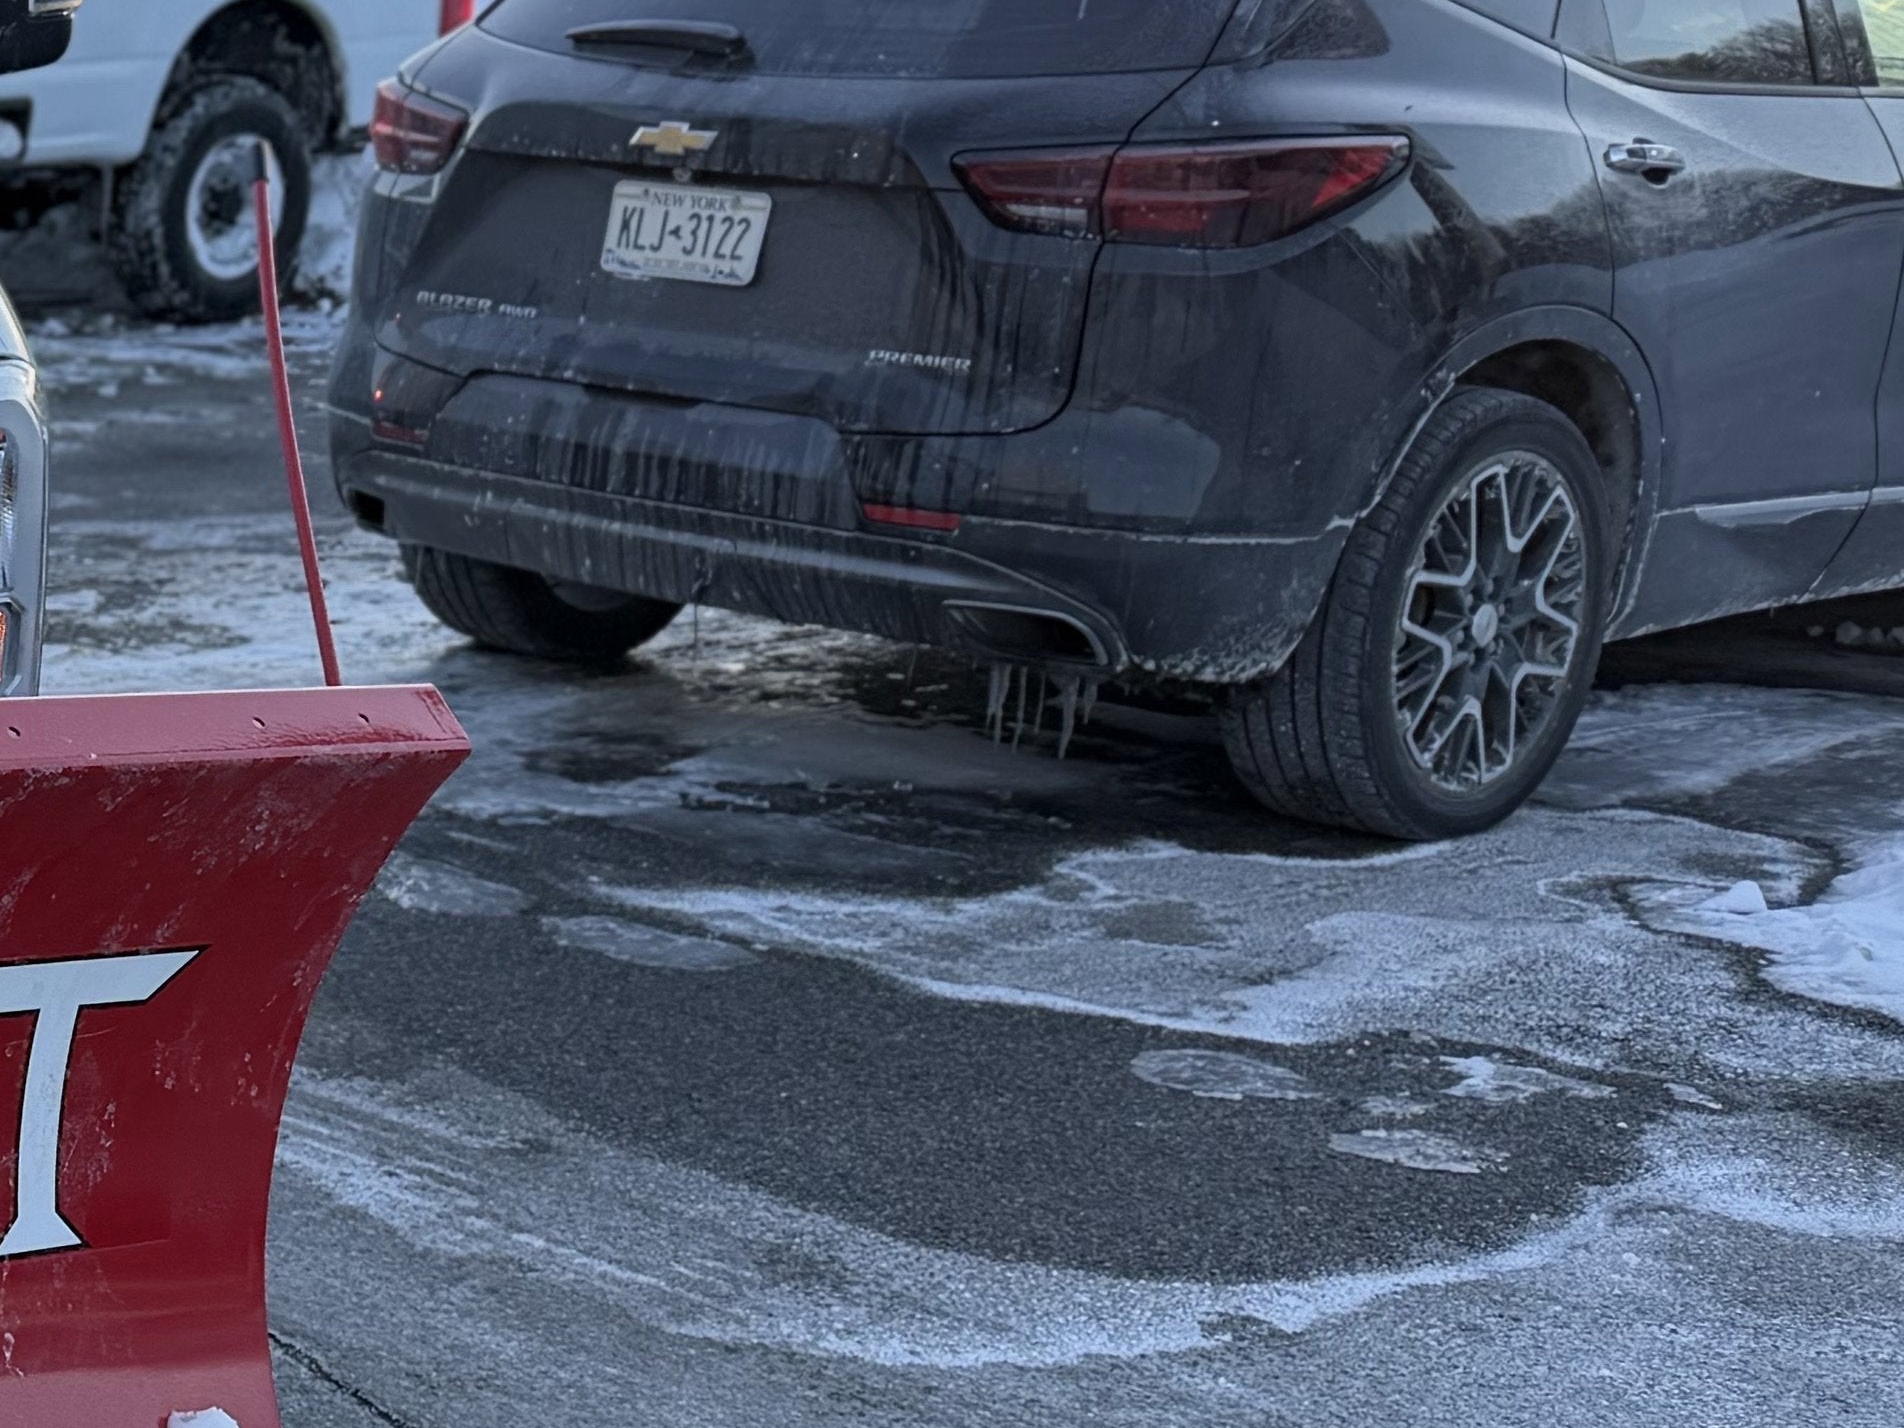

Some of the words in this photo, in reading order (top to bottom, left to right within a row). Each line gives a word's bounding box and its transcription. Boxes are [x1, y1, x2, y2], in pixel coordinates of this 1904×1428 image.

[650, 192, 686, 209] NEW
[691, 195, 728, 213] YORK
[865, 349, 972, 374] PREMIER
